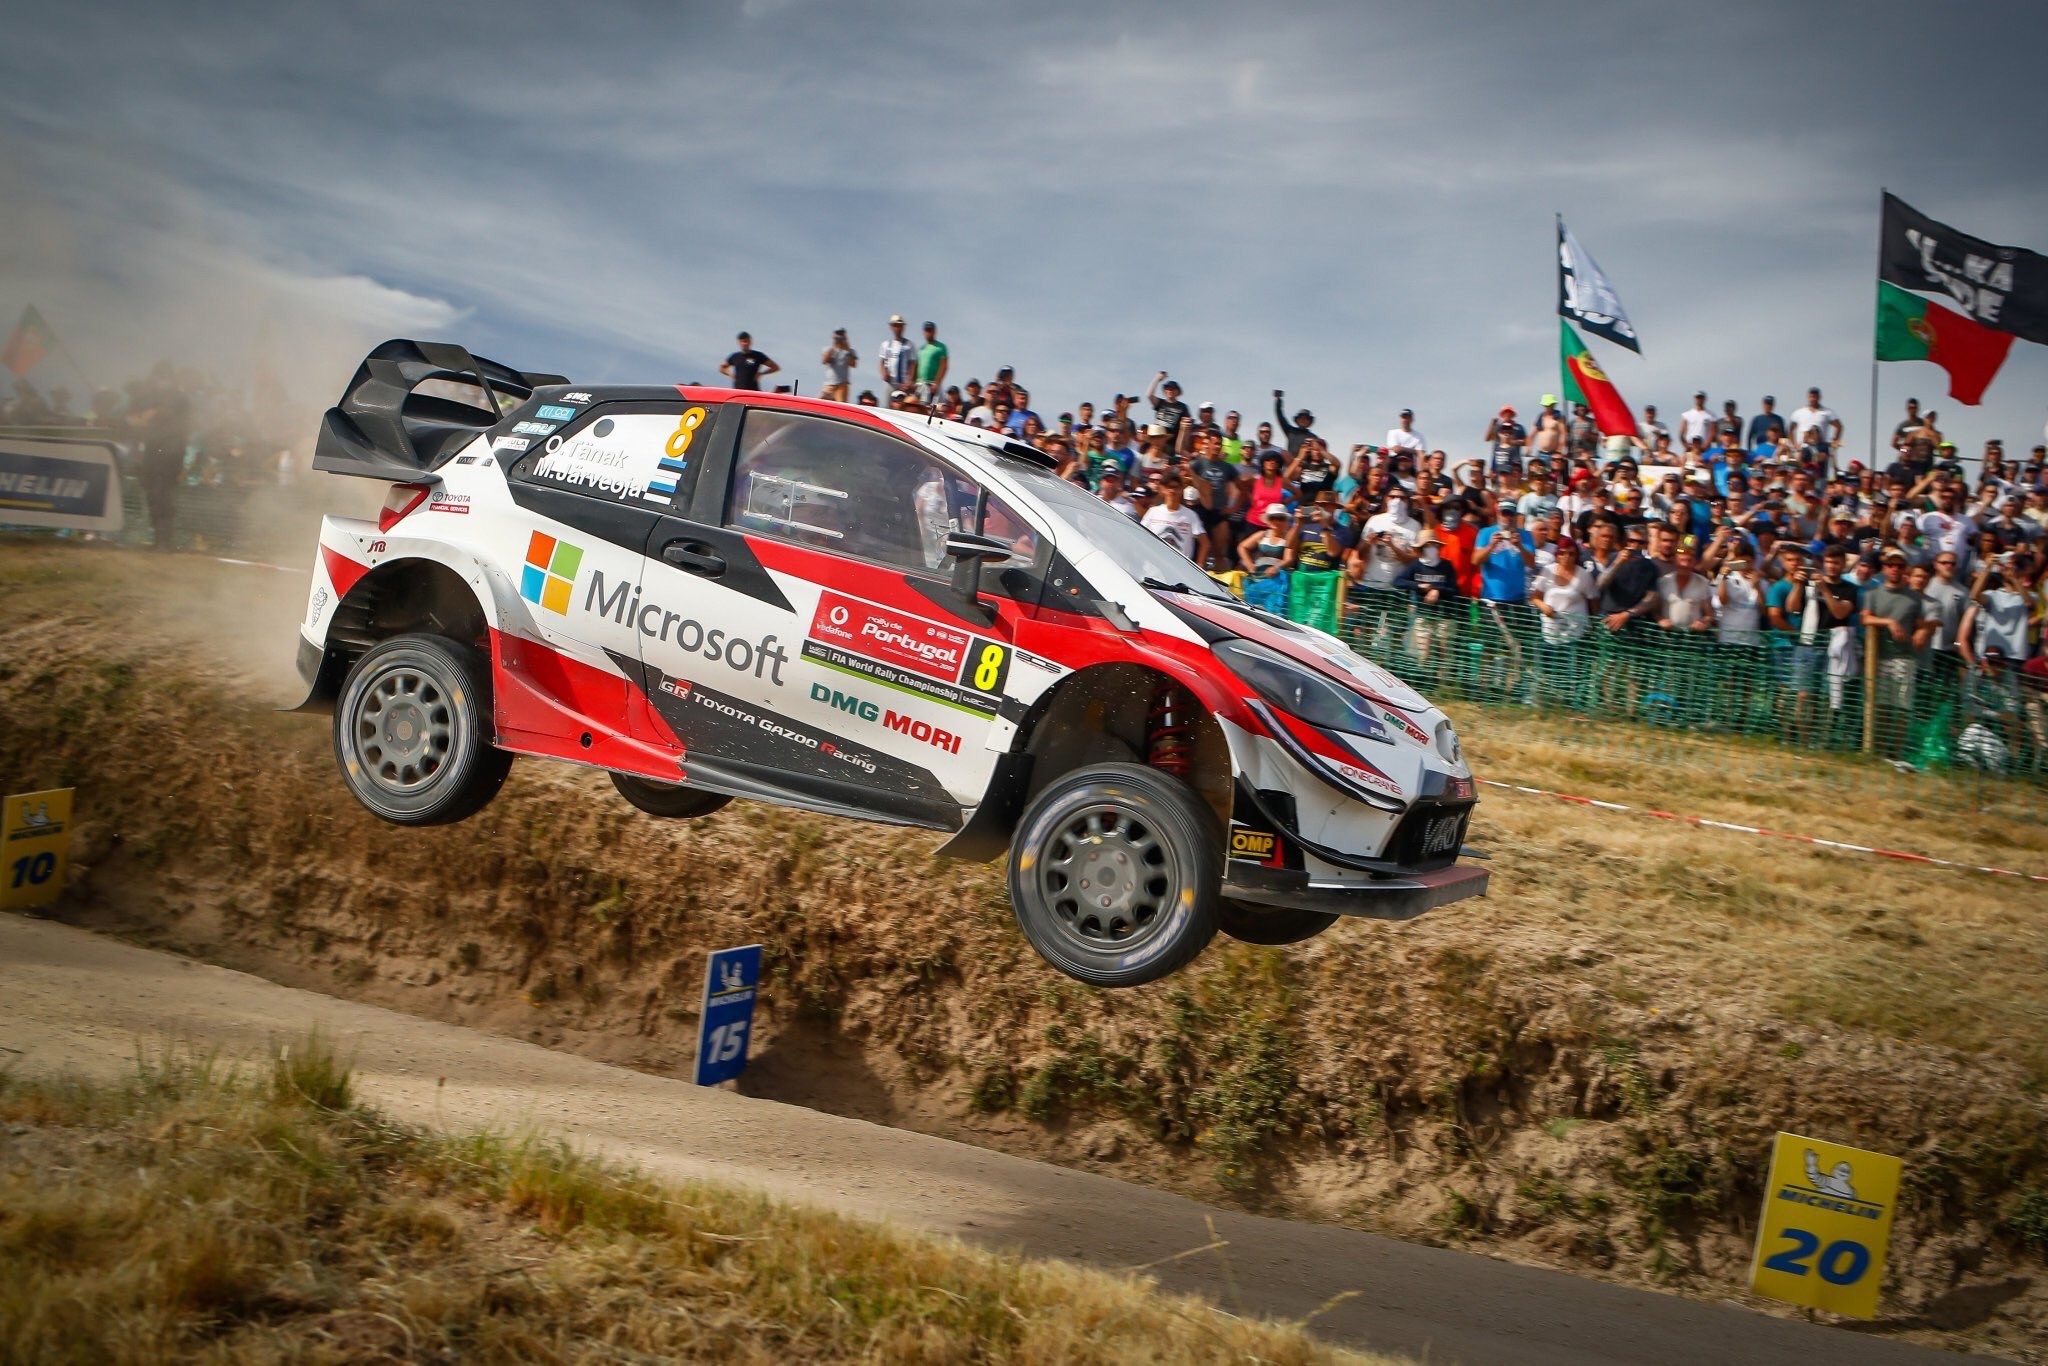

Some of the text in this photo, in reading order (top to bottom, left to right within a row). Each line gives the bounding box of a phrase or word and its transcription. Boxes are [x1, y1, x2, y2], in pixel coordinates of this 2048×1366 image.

[665, 406, 706, 458] 8
[444, 493, 471, 503] TOYOTA
[367, 541, 386, 553] JTB
[584, 569, 789, 687] Microsoft
[816, 622, 853, 640] vodafone
[861, 622, 958, 664] Portugal
[867, 616, 903, 631] rally de
[831, 652, 847, 665] FIA
[848, 657, 874, 673] World
[875, 666, 897, 682] Rally
[898, 674, 959, 701] Championship
[974, 644, 1004, 691] 8
[661, 681, 877, 774] GR TOYOTA GAZOO Racing
[810, 682, 963, 755] DMG MORI
[1383, 711, 1430, 746] DMG MORI
[1339, 765, 1403, 796] KONECRANES
[1232, 834, 1274, 853] OMP
[9, 851, 57, 889] 10
[706, 1020, 749, 1065] 15
[1762, 1226, 1872, 1287] 20
